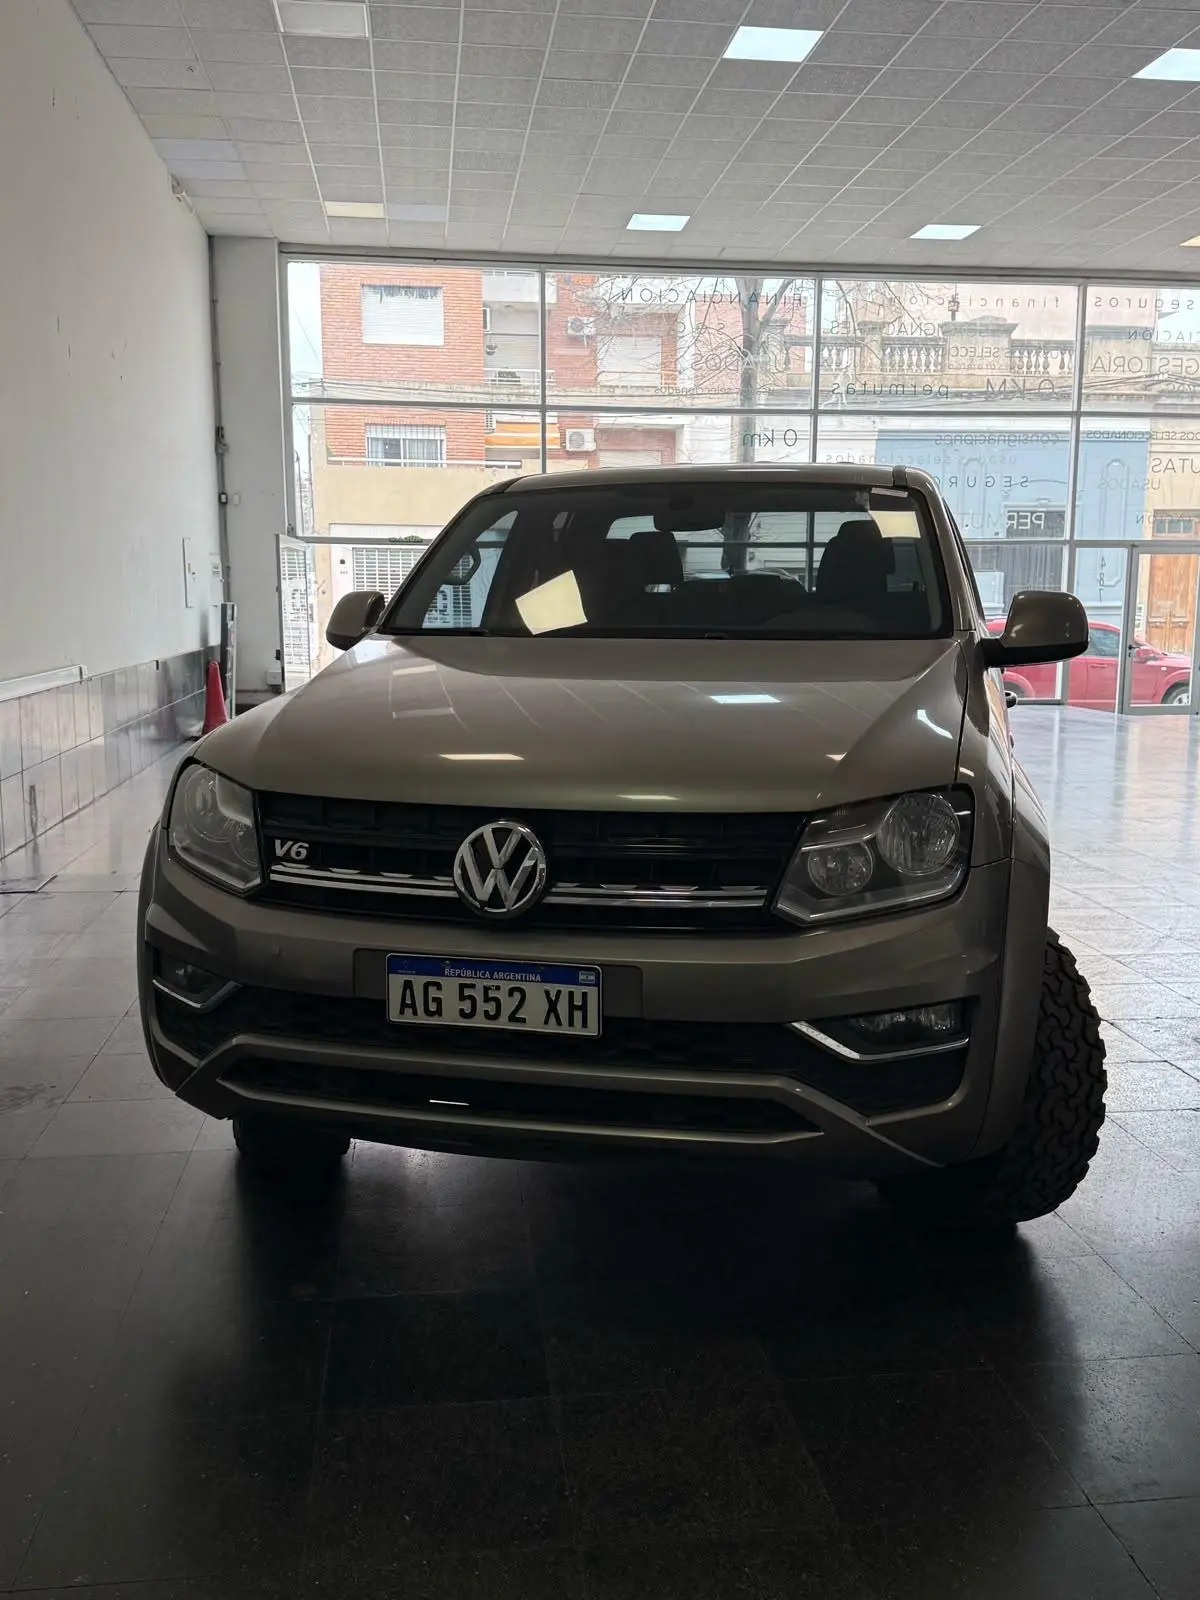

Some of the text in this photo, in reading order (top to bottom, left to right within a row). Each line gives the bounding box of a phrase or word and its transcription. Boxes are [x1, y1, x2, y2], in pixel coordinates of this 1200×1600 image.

[273, 838, 310, 861] V6
[444, 967, 542, 983] REPÚBLICA ARGENTINA
[398, 979, 589, 1029] AG 552 XH
